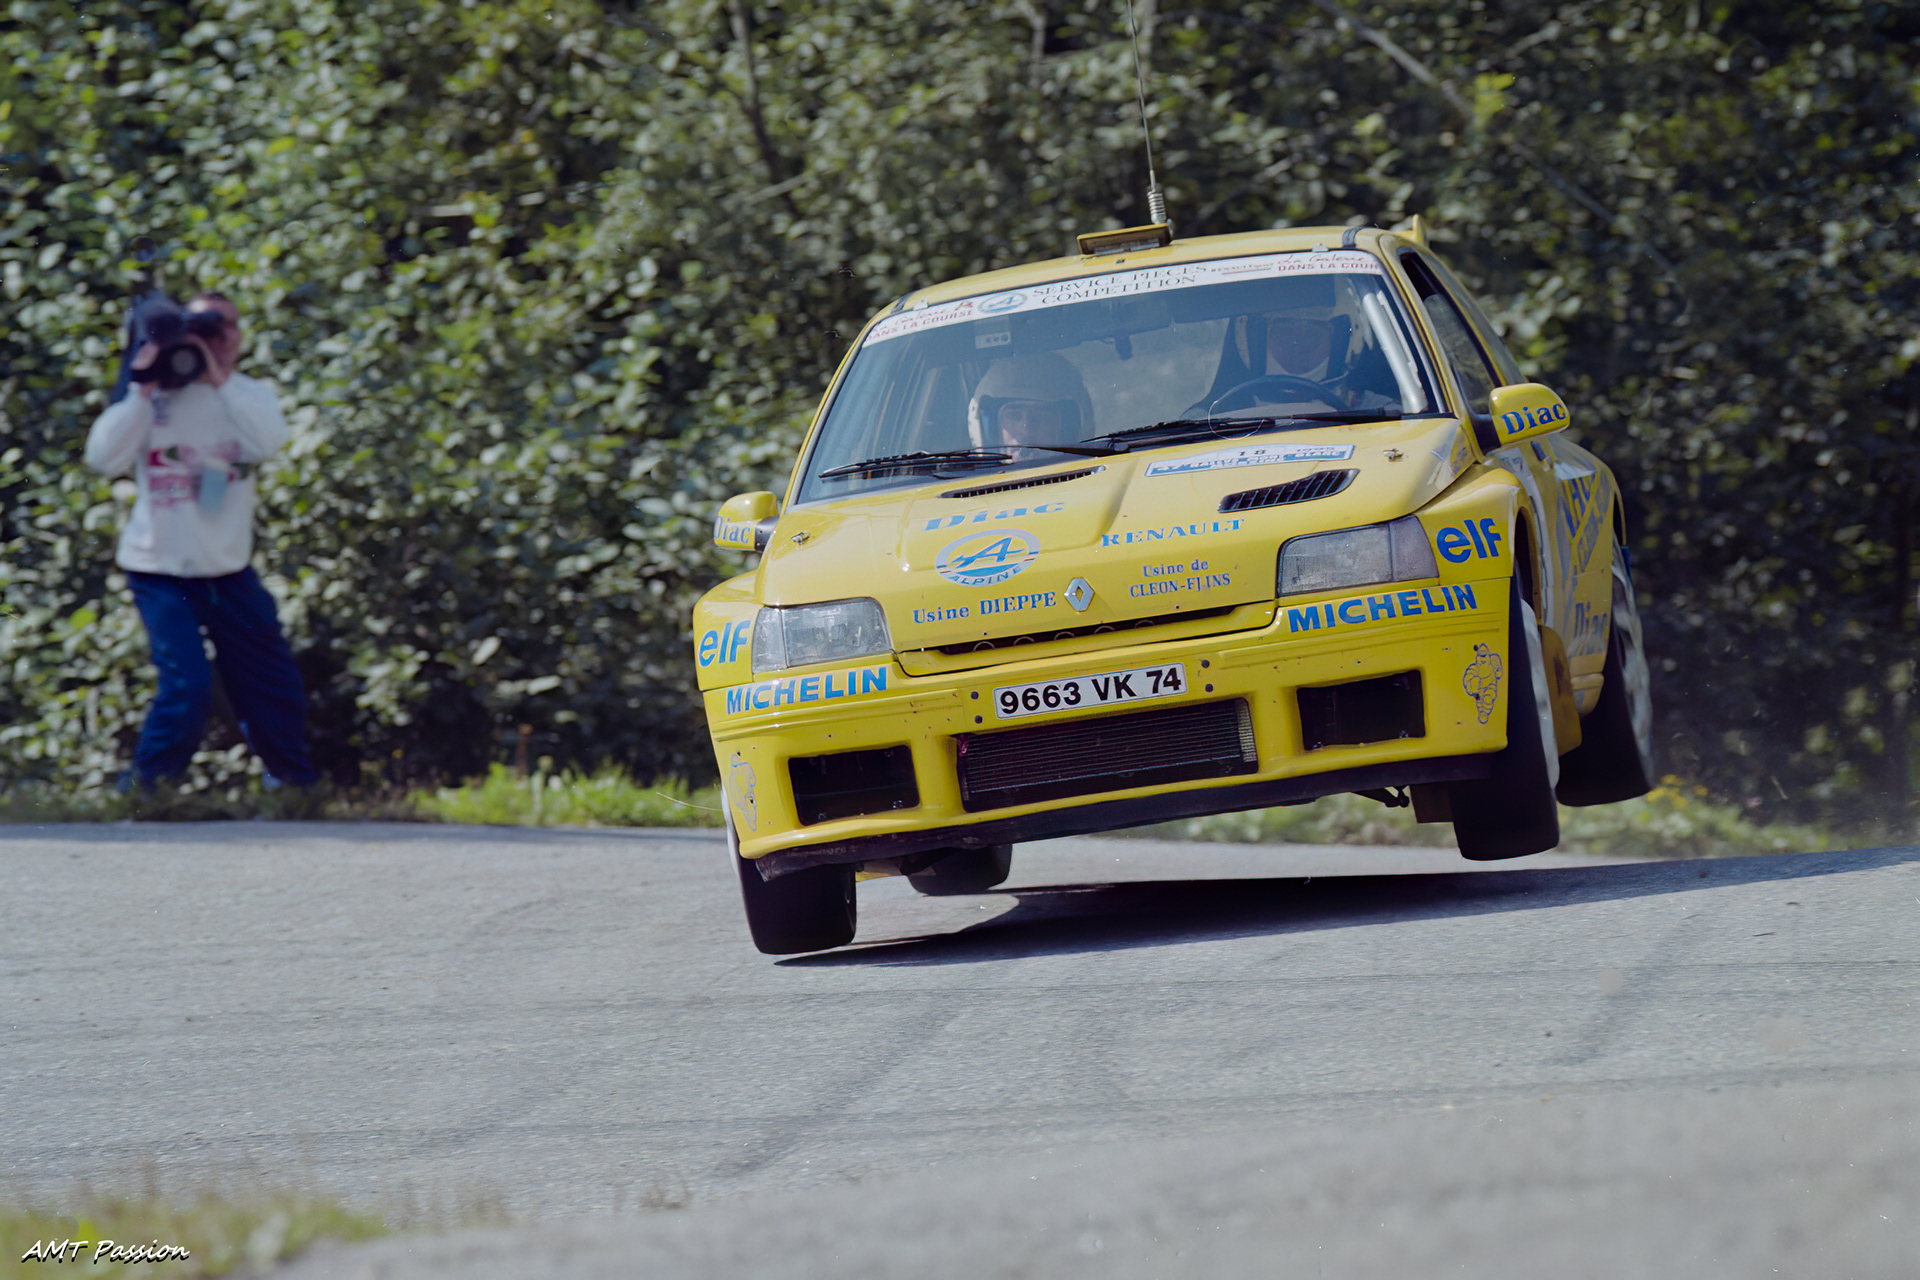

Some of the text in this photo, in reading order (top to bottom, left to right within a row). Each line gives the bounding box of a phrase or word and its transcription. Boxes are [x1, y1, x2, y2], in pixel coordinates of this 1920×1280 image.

[1033, 264, 1207, 297] SERVICE PIECES
[1278, 262, 1314, 272] DANS
[1319, 262, 1337, 271] LA
[1041, 275, 1197, 304] COMPETITION
[1501, 402, 1567, 435] Diac
[714, 515, 751, 545] Diac
[924, 501, 1066, 531] Diac
[1101, 518, 1246, 547] RENAULT
[1437, 518, 1501, 563] elf
[948, 565, 1021, 585] ALPINE
[1143, 559, 1208, 577] Usine de
[913, 591, 1057, 624] Usine DIEPPE
[1287, 583, 1477, 633] MICHELIN
[698, 620, 751, 668] elf
[726, 666, 887, 715] MICHELIN
[1000, 667, 1182, 715] 9663 VK 74
